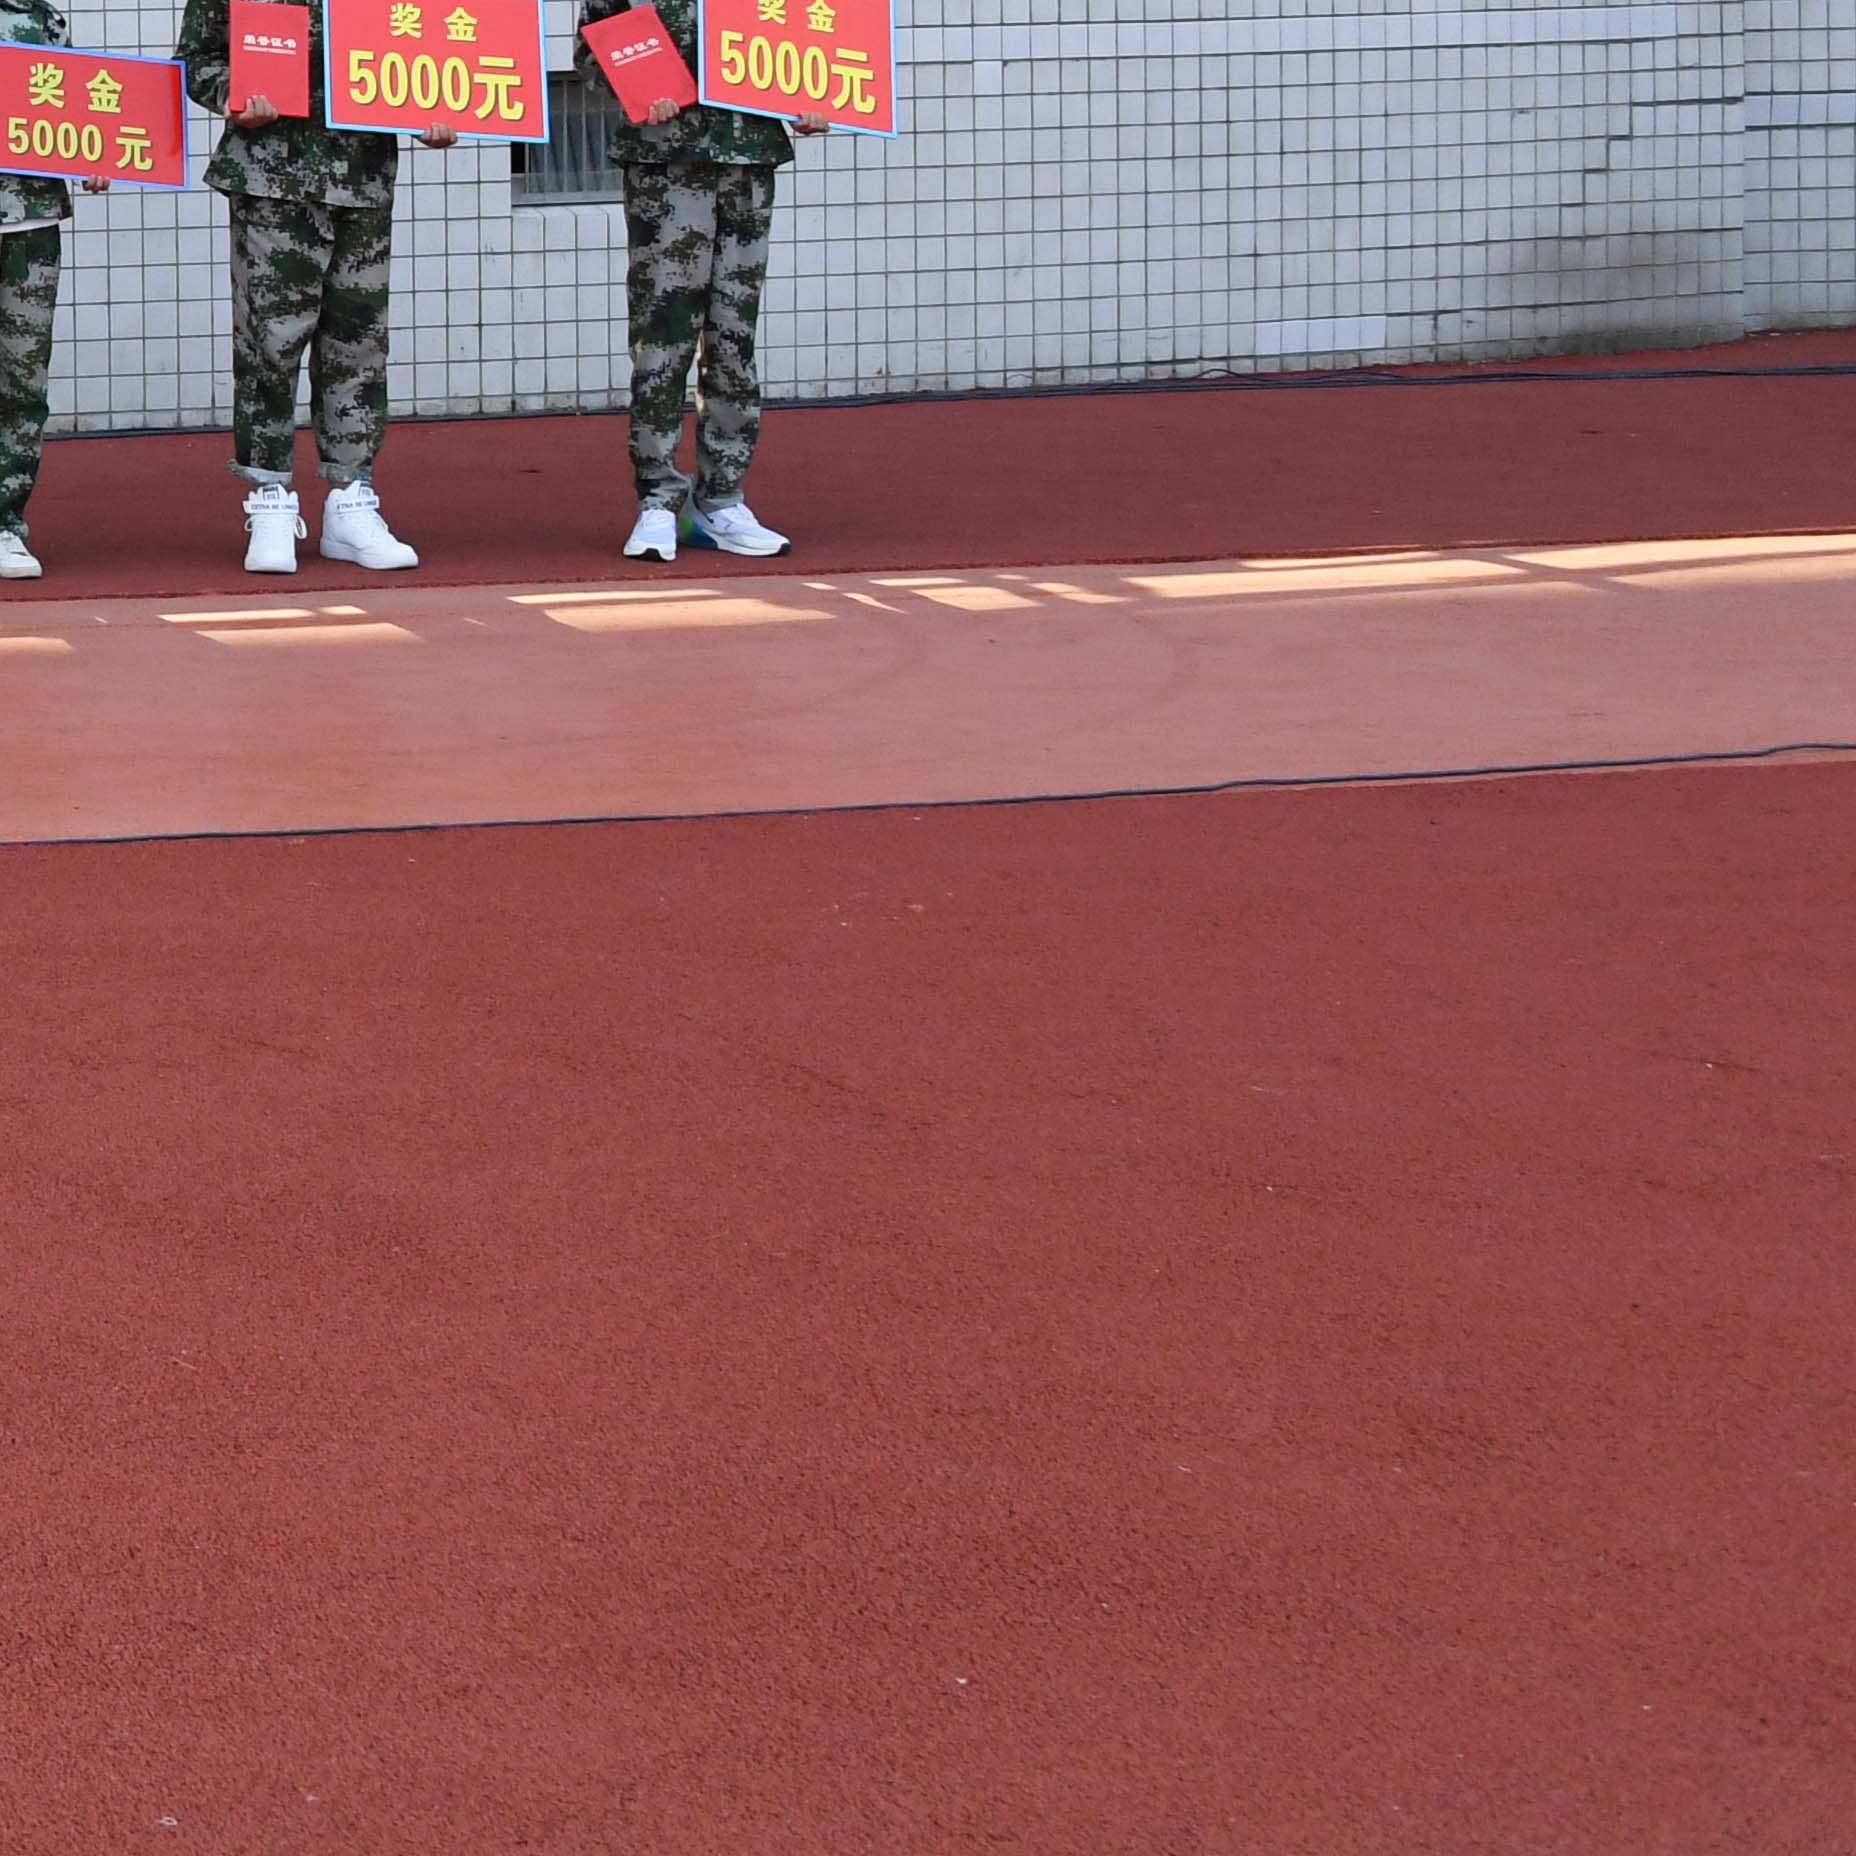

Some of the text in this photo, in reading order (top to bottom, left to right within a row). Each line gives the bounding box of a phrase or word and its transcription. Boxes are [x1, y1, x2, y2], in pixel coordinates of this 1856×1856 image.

[391, 3, 477, 42] 奖金
[31, 64, 123, 113] 奖金
[349, 49, 524, 121] 5000元
[720, 30, 876, 114] 5000元
[9, 117, 153, 171] 5000元
